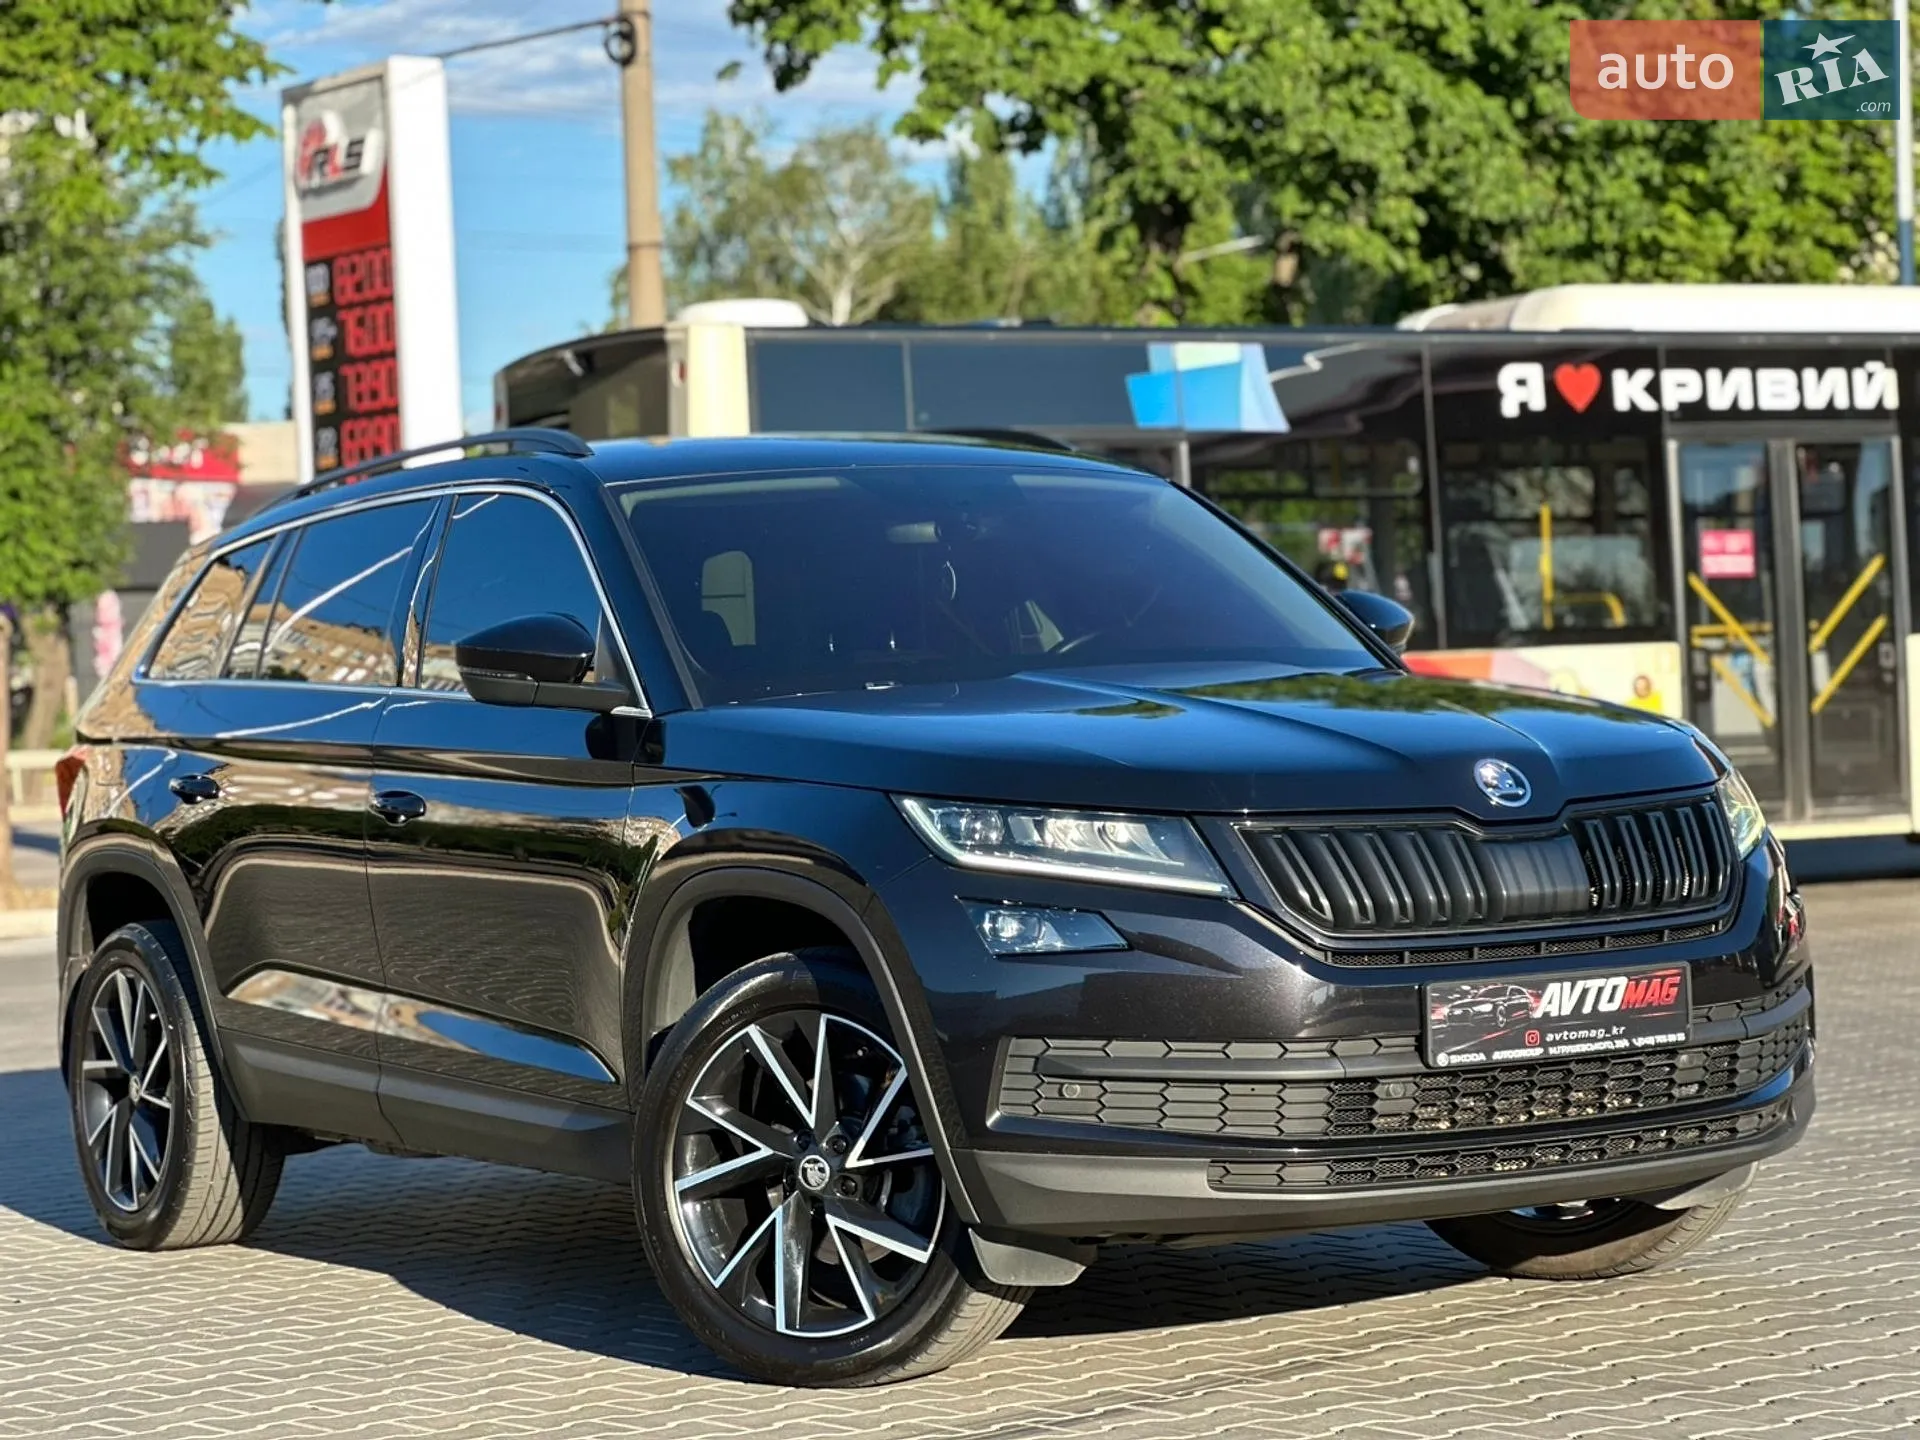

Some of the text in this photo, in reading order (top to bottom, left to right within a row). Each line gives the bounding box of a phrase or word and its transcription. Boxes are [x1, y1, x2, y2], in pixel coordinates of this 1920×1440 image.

[1496, 360, 1900, 419] Я КРИВИЙ
[1533, 976, 1681, 1018] AVTOMAG
[1546, 1025, 1626, 1042] avtomag_kr
